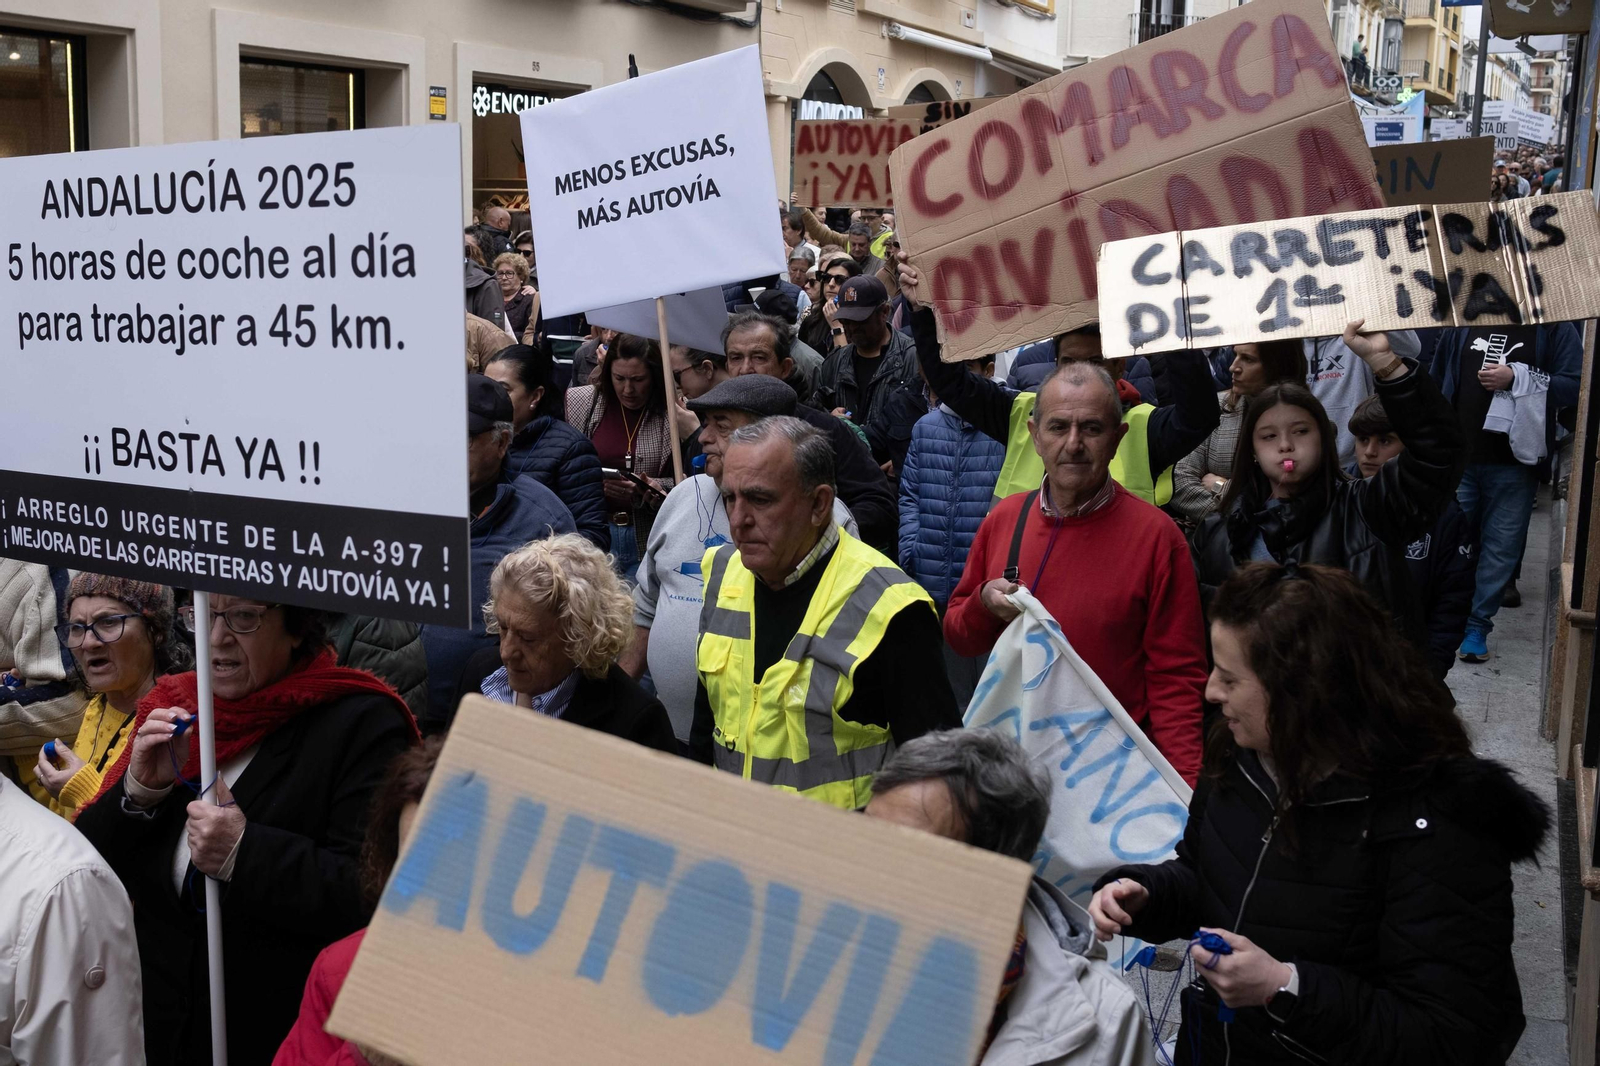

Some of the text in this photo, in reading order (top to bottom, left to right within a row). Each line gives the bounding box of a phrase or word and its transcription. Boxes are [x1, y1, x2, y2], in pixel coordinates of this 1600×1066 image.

[801, 99, 864, 120] MOMODA
[908, 12, 1342, 219] COMARCA
[1465, 121, 1508, 134] BSTA DE
[41, 158, 357, 220] ANDALUCÍA 2025
[555, 134, 735, 196] MENOS EXCUSAS,
[577, 173, 721, 229] MÁS AUTOVÍA
[8, 231, 416, 282] 5 horas de coche al día
[1131, 203, 1567, 288] CARRETERAS
[18, 303, 405, 356] para trabajar a 45 km.
[1125, 295, 1224, 348] DE
[1390, 263, 1545, 324] ¡YA!
[83, 427, 321, 485] ¡¡ BASTA YA !!
[17, 497, 108, 528] ARREGLO
[121, 509, 229, 545] URGENTE
[244, 525, 276, 550] DE
[292, 530, 324, 557] LA
[342, 536, 423, 568] A-397
[443, 546, 449, 572] !
[4, 525, 450, 609] ¡ MEJORA DE LAS CARRETERAS Y AUTOVÍA YA !
[381, 768, 986, 1066] AUTOVIA
